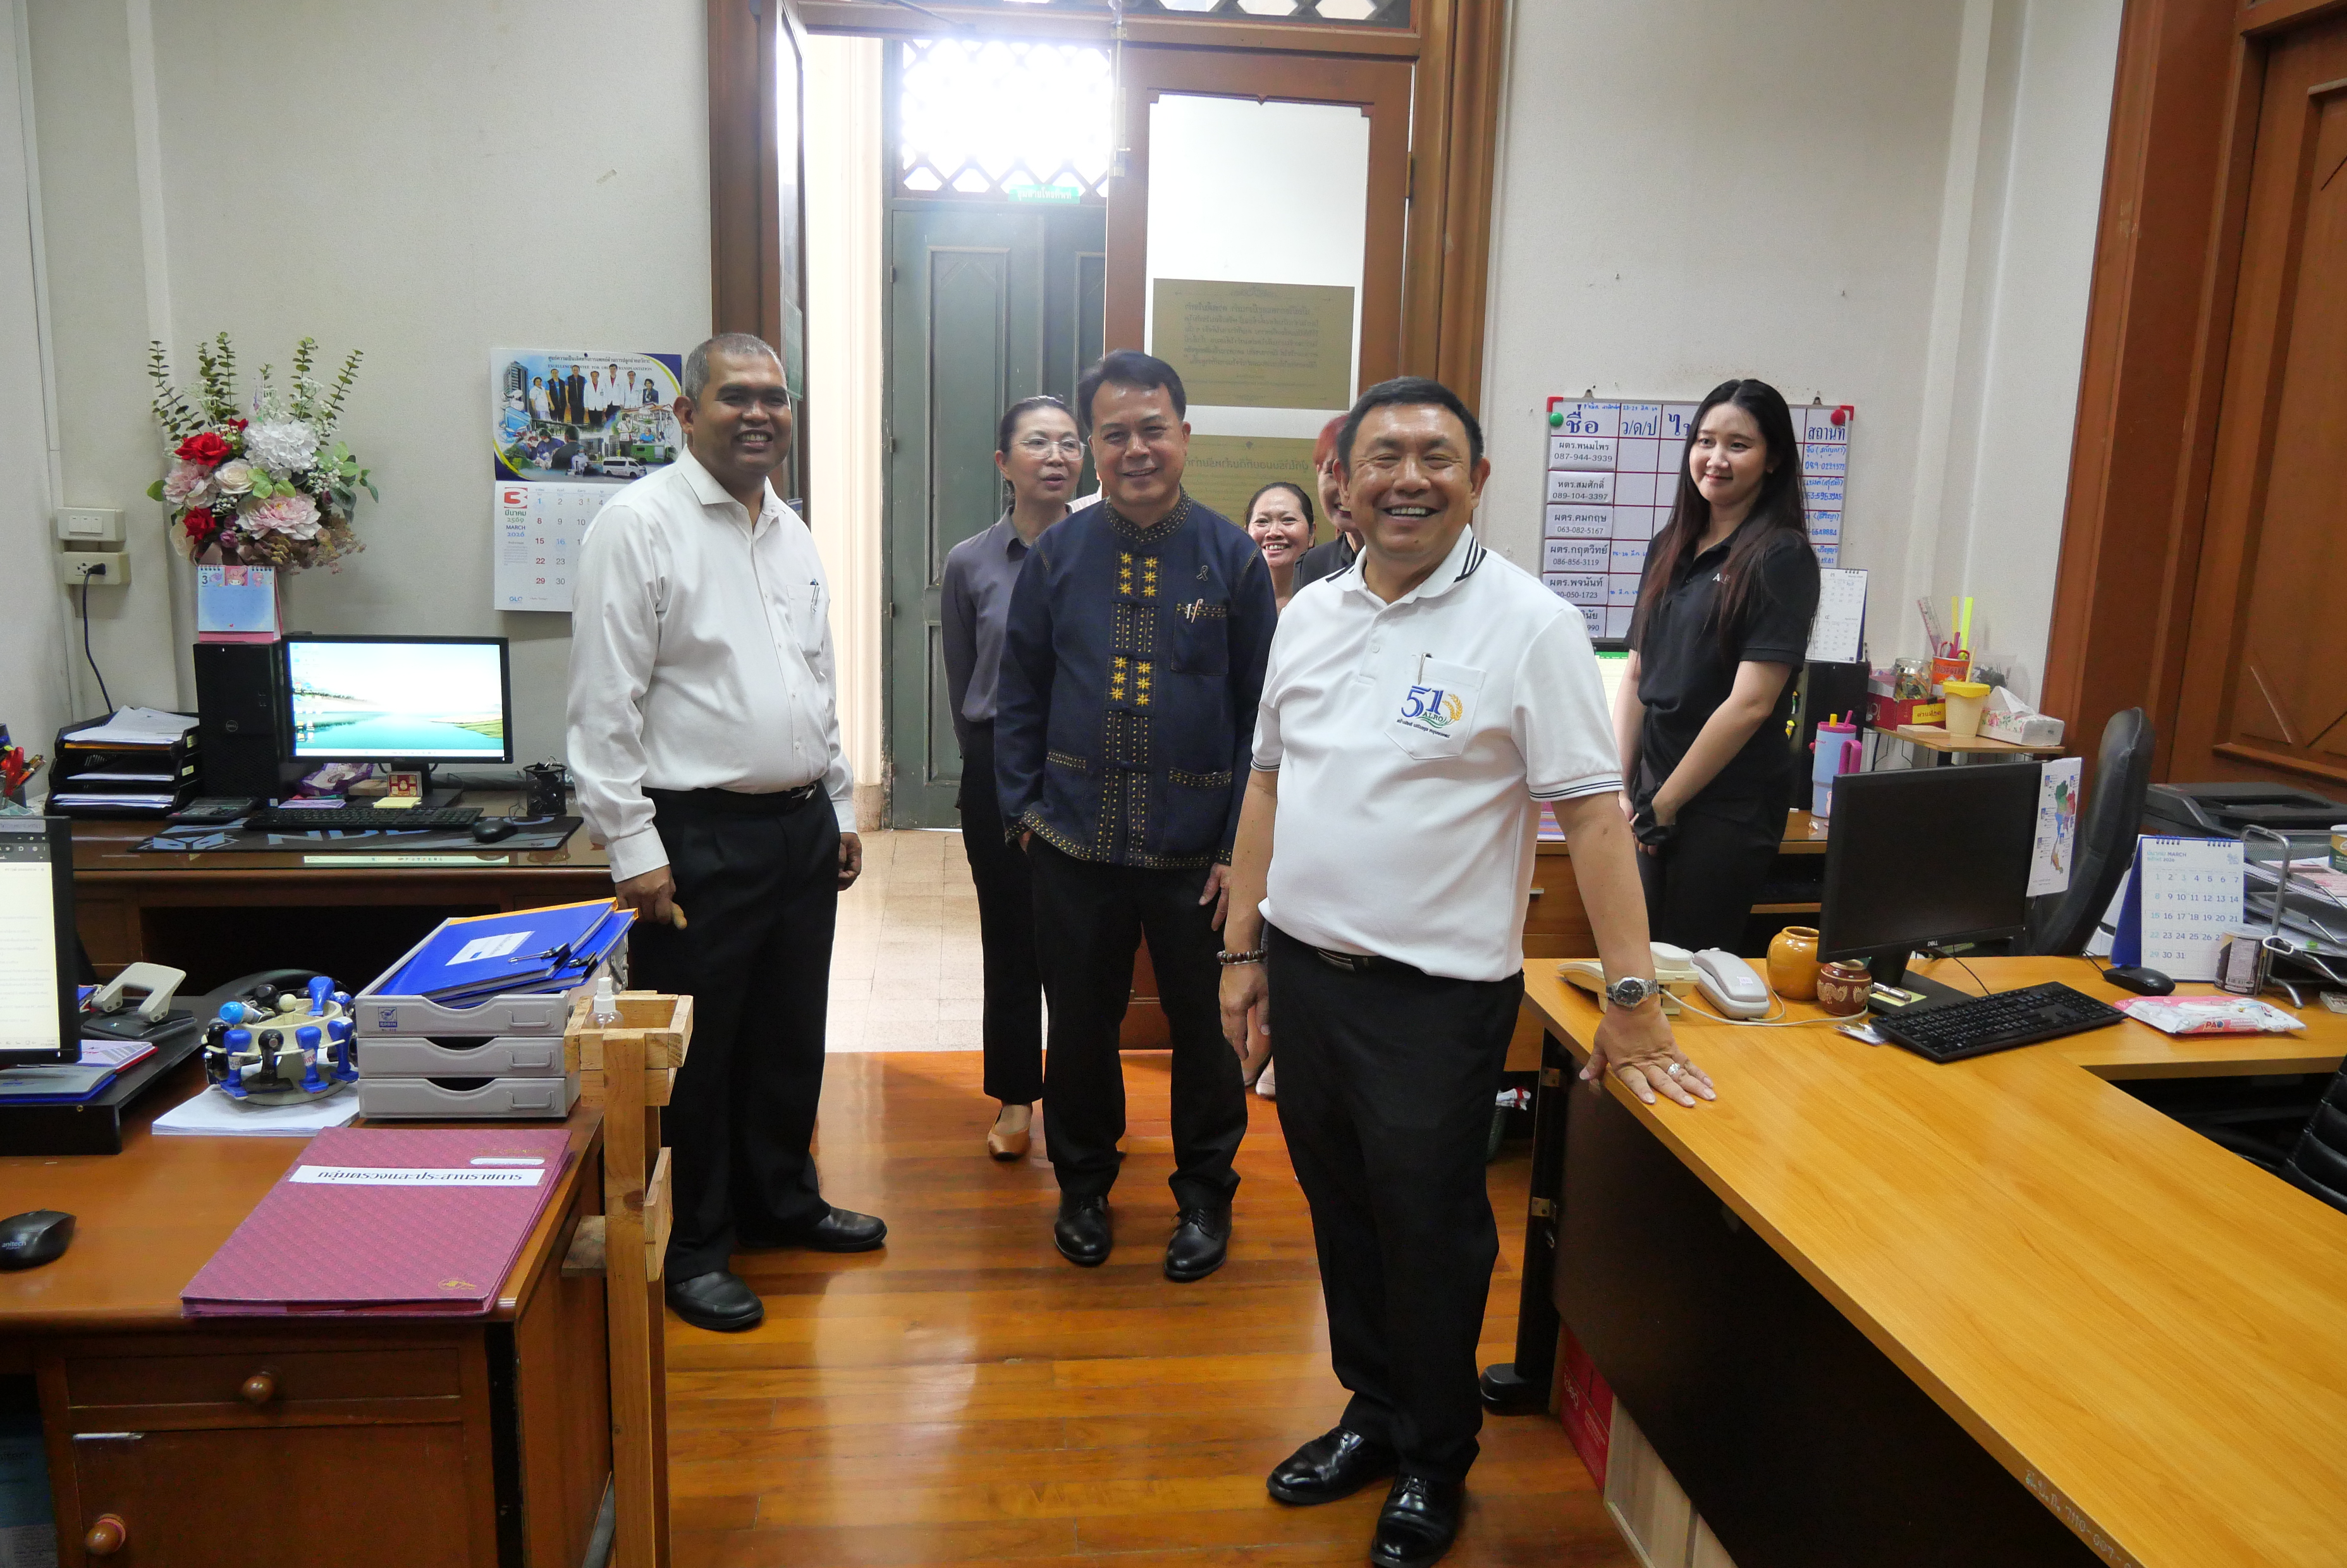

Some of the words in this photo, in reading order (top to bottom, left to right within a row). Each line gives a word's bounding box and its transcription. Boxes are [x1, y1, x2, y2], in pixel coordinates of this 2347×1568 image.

[1621, 415, 1657, 436] ว/ด/ป
[1559, 441, 1609, 451] ผตร.พนมไพร
[1554, 453, 1612, 462] 087-944-3939
[1558, 477, 1605, 489] หตร.สมศักดิ์
[1555, 514, 1607, 524] ผตร.คมกฤษ
[1557, 526, 1603, 534] 063-082-5167
[1550, 544, 1609, 556] ผตร.กฤตวิทย์
[202, 575, 208, 584] 3
[1550, 577, 1603, 587] ผตร.พจนันท์
[1401, 685, 1444, 718] 51
[1423, 711, 1443, 722] ALRO
[318, 1170, 522, 1180] กลุ่มตรวจและประสานราชการ
